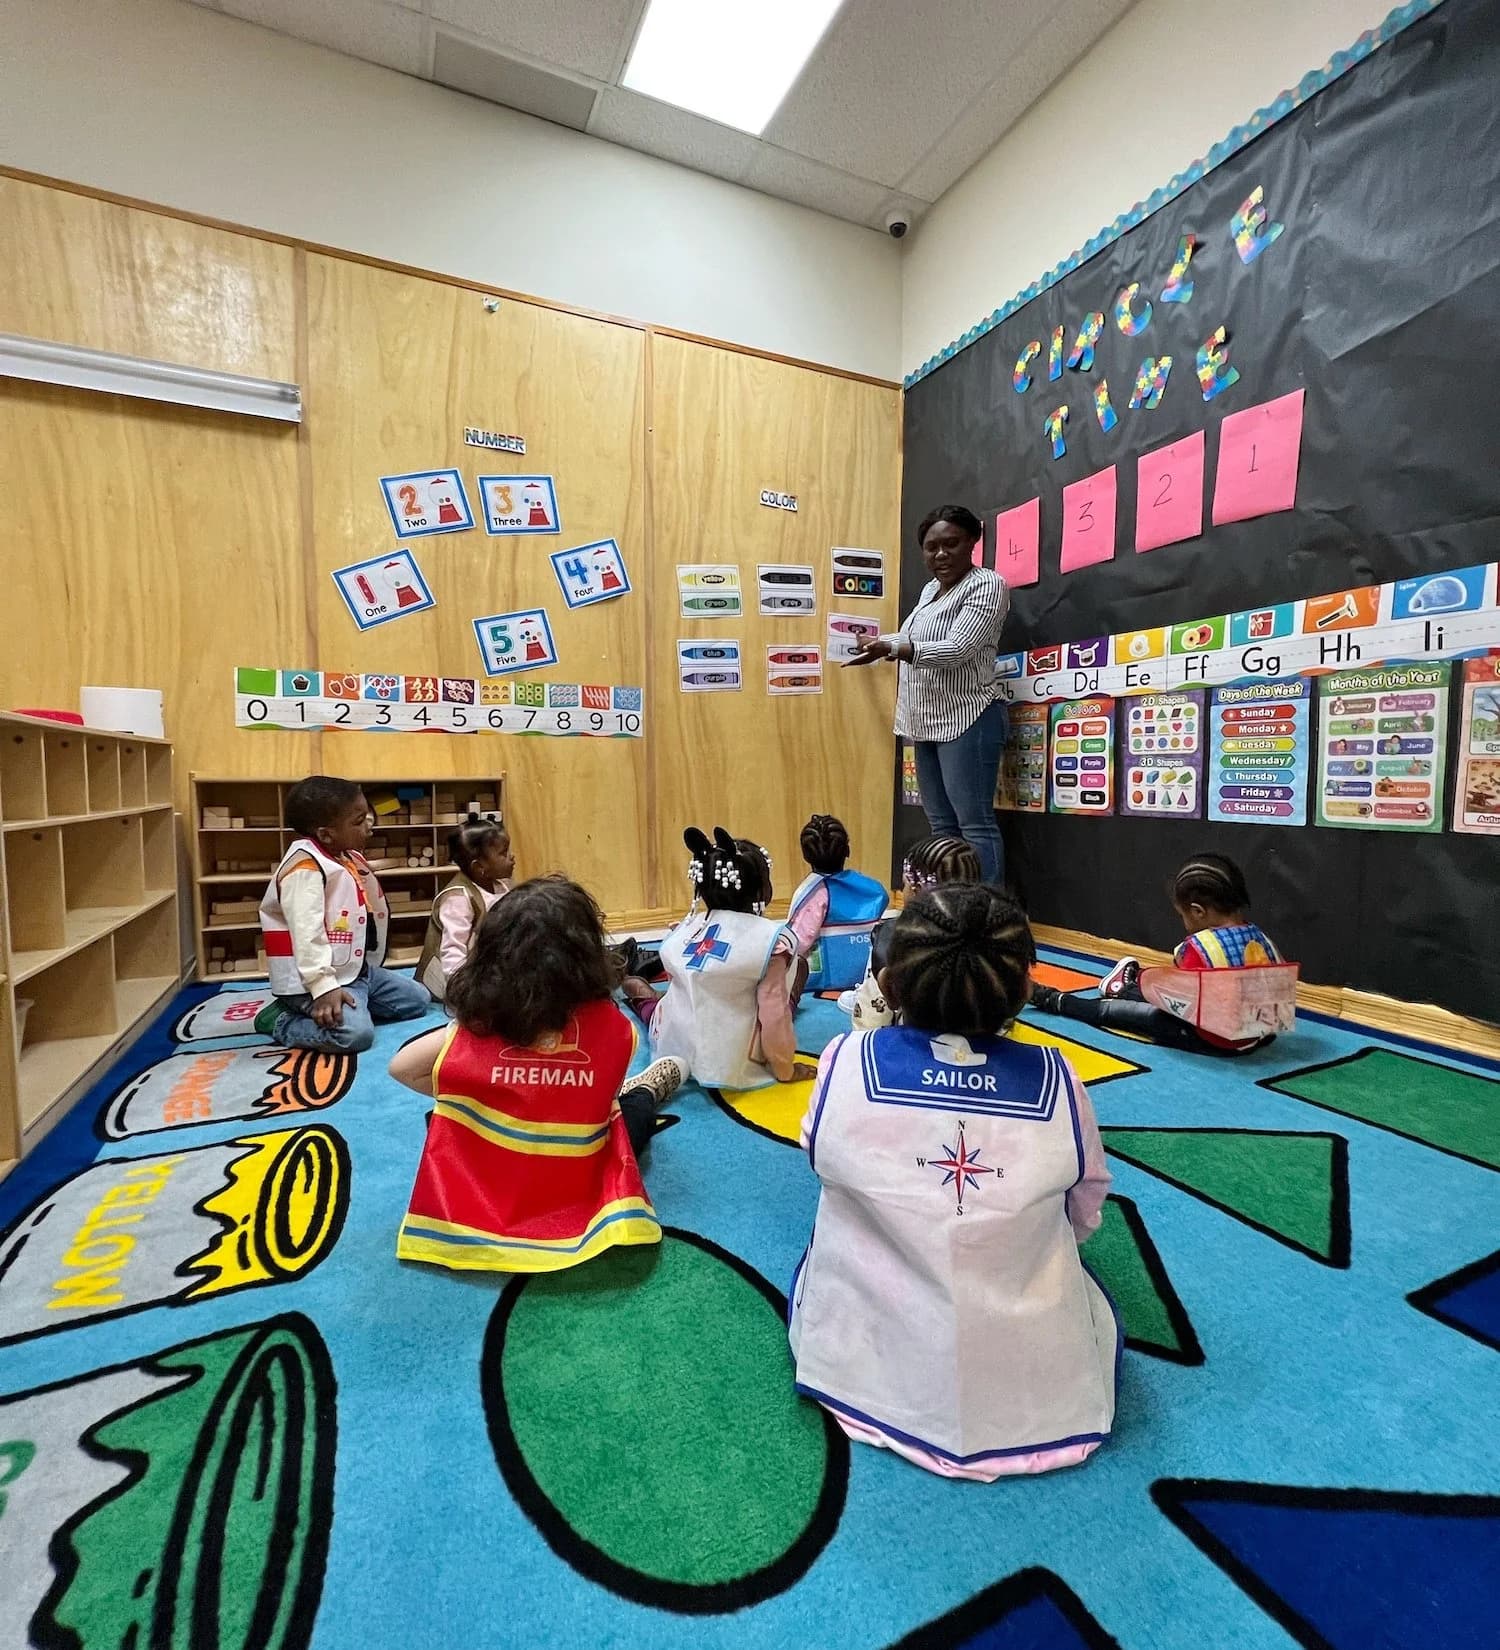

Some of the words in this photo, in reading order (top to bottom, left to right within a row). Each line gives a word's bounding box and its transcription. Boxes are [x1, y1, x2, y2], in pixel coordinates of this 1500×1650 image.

[1013, 184, 1285, 393] CIRCLE
[1044, 325, 1240, 460] TIME
[464, 426, 526, 453] NUMBER
[1248, 443, 1260, 474] 1
[760, 489, 797, 510] COLOR
[1152, 473, 1173, 508] 2
[397, 483, 423, 517] 2
[493, 485, 514, 515] 3
[404, 517, 428, 528] Two
[493, 516, 523, 527] Three
[1076, 501, 1095, 533] 3
[1008, 537, 1025, 562] 4
[562, 556, 590, 587] 4
[353, 572, 378, 607] 1
[573, 586, 595, 599] Four
[835, 575, 882, 593] Colors
[365, 603, 388, 618] One
[488, 625, 515, 656] 5
[495, 654, 518, 666] Five
[1033, 676, 1054, 697] Cc
[1073, 668, 1100, 693] Dd
[1125, 663, 1152, 688] Ee
[1184, 653, 1211, 682] Ff
[1240, 645, 1282, 676] Gg
[1319, 632, 1362, 665] Hh
[1328, 675, 1369, 691] Months
[1370, 674, 1385, 688] of
[1385, 672, 1407, 687] the
[1407, 669, 1440, 685] Year
[1141, 697, 1156, 707] 2D
[1157, 695, 1186, 708] Shapes
[1219, 689, 1241, 703] Days
[1242, 687, 1255, 699] of
[1255, 685, 1271, 698] the
[1272, 683, 1303, 697] Week
[1397, 697, 1432, 707] February
[246, 698, 269, 722] 0
[295, 701, 306, 723] 1
[334, 702, 352, 724] 2
[374, 703, 392, 726] 3
[412, 705, 432, 727] 4
[451, 706, 468, 728] 5
[487, 707, 504, 729] 6
[523, 709, 538, 730] 7
[556, 710, 573, 731] 8
[589, 712, 605, 732] 9
[614, 712, 641, 732] 10
[1063, 703, 1102, 718] Colors
[1239, 707, 1277, 720] Sunday
[1238, 724, 1277, 735] Monday
[1237, 740, 1278, 751] Tuesday
[1405, 742, 1426, 750] June
[1140, 758, 1154, 768] 3D
[1156, 757, 1184, 770] Shapes
[1229, 755, 1287, 767] Wednesday
[1234, 772, 1279, 783] Thursday
[1240, 787, 1271, 799] Friday
[1233, 802, 1278, 814] Saturday
[222, 1000, 265, 1021] RED
[490, 1065, 595, 1088] FIREMAN
[921, 1068, 998, 1092] SAILOR
[957, 1120, 966, 1130] N
[916, 1157, 928, 1168] W
[996, 1167, 1005, 1179] E
[956, 1205, 964, 1216] S
[46, 1155, 188, 1310] YELLOW
